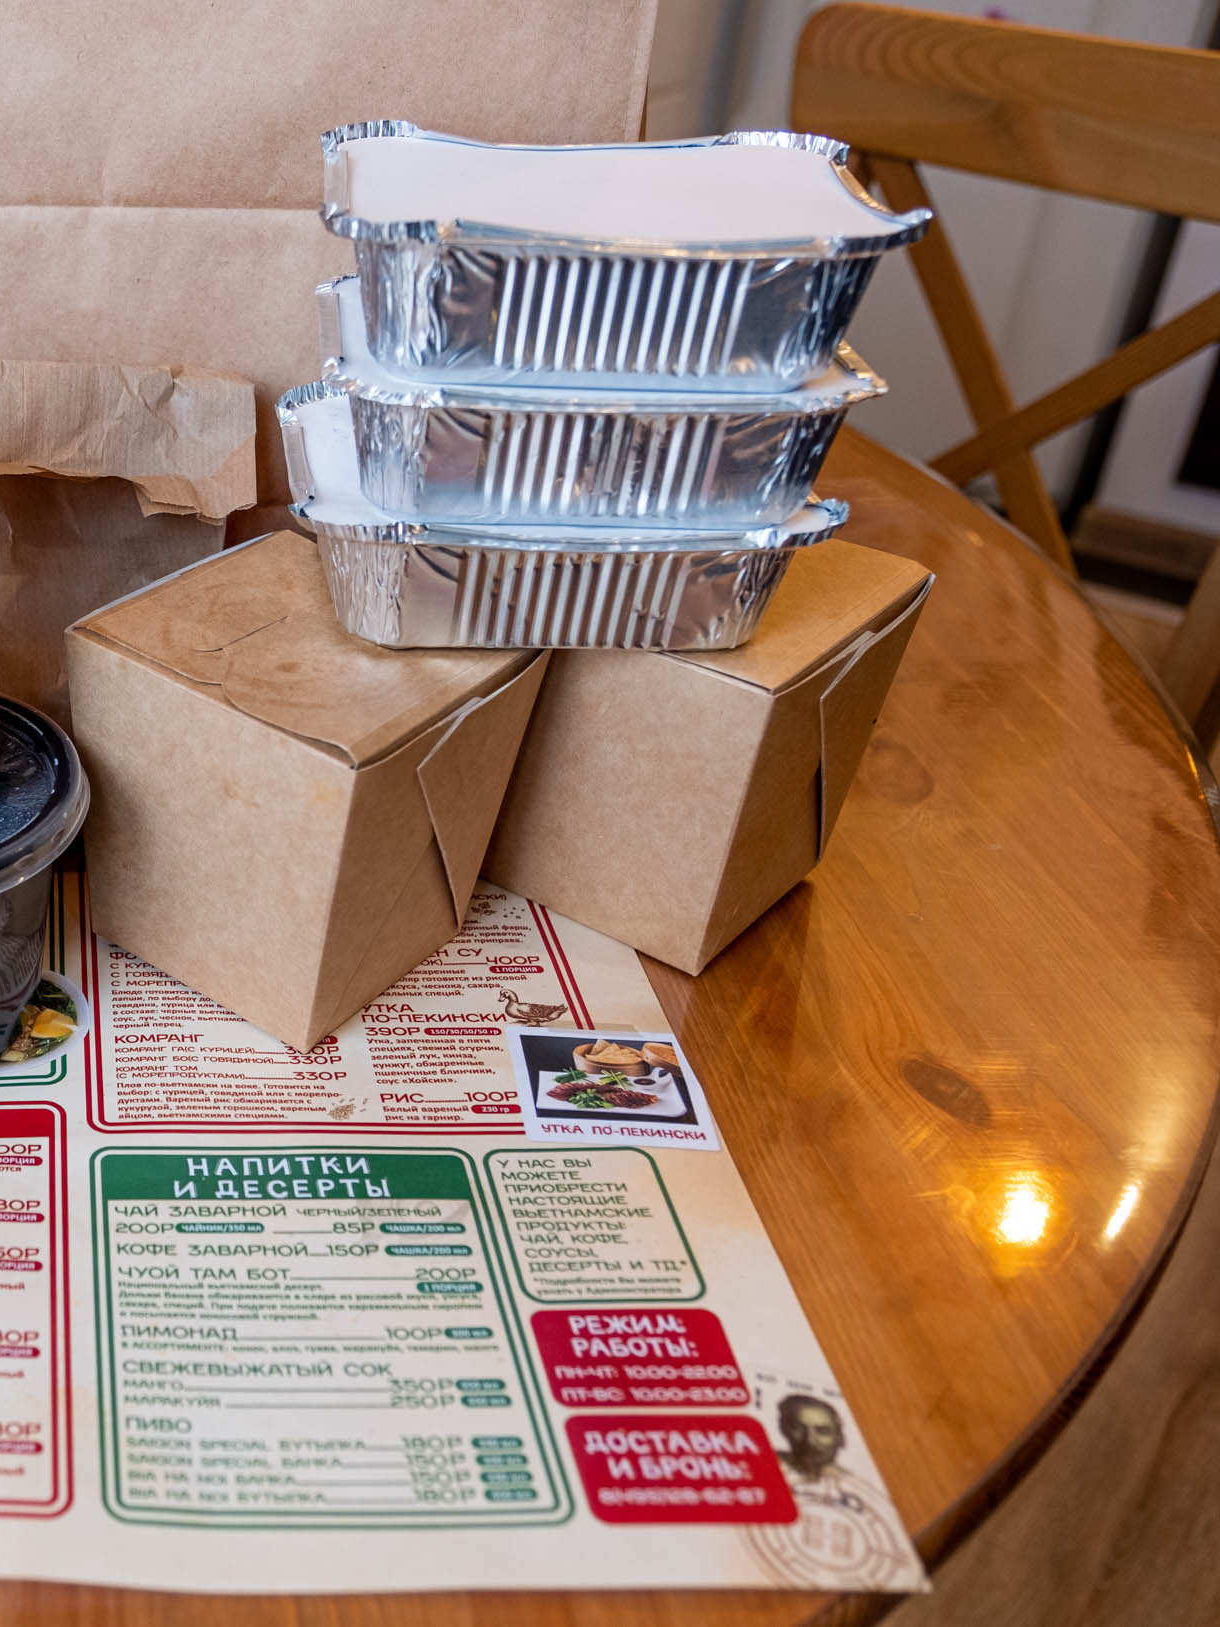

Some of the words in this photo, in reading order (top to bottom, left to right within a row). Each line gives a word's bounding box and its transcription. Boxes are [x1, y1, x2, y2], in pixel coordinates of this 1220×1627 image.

[457, 949, 483, 957] СУ
[486, 956, 540, 965] 400Р
[363, 1003, 414, 1013] УТКА
[361, 1013, 507, 1023] ПО-ПЕКИНСКИ
[365, 1027, 420, 1036] 390Р
[114, 1034, 204, 1044] КОМРАНГ
[288, 1056, 342, 1064] 330Р
[292, 1072, 347, 1081] 330Р
[380, 1093, 424, 1103] РИС
[463, 1091, 518, 1102] 100Р
[541, 1124, 584, 1134] УТКА
[592, 1125, 707, 1141] ПО-ПЕКИНСКИ
[187, 1156, 370, 1176] НАПИТКИ
[497, 1159, 509, 1168] У
[519, 1159, 555, 1168] НАС
[563, 1159, 592, 1168] ВЫ
[501, 1171, 580, 1181] МОЖЕТЕ
[174, 1180, 198, 1198] И
[215, 1179, 391, 1198] ДЕСЕРТЫ
[504, 1183, 628, 1193] ПРИОБРЕСТИ
[508, 1195, 628, 1206] НАСТОЯЩИЕ
[114, 1203, 159, 1217] ЧАЙ
[169, 1203, 287, 1217] ЗАВАРНОЙ
[512, 1208, 653, 1218] ВЬЕТНАМСКИЕ
[115, 1223, 175, 1234] 200Р
[332, 1223, 375, 1234] 85Р
[117, 1244, 177, 1256] КОФЕ
[188, 1242, 309, 1256] ЗАВАРНОЙ
[328, 1245, 380, 1256] 150Р
[530, 1260, 622, 1273] ДЕСЕРТЫ
[118, 1265, 179, 1279] ЧУОЙ
[190, 1268, 237, 1280] ТАМ
[247, 1269, 291, 1280] БОТ
[415, 1268, 477, 1281] 200Р
[571, 1337, 700, 1357] РАБОТЫ:
[123, 1360, 332, 1377] СВЕЖЕВЫЖАТЫЙ
[343, 1363, 393, 1378] СОК
[584, 1430, 760, 1454] ДОСТАВКА
[607, 1456, 635, 1480] И
